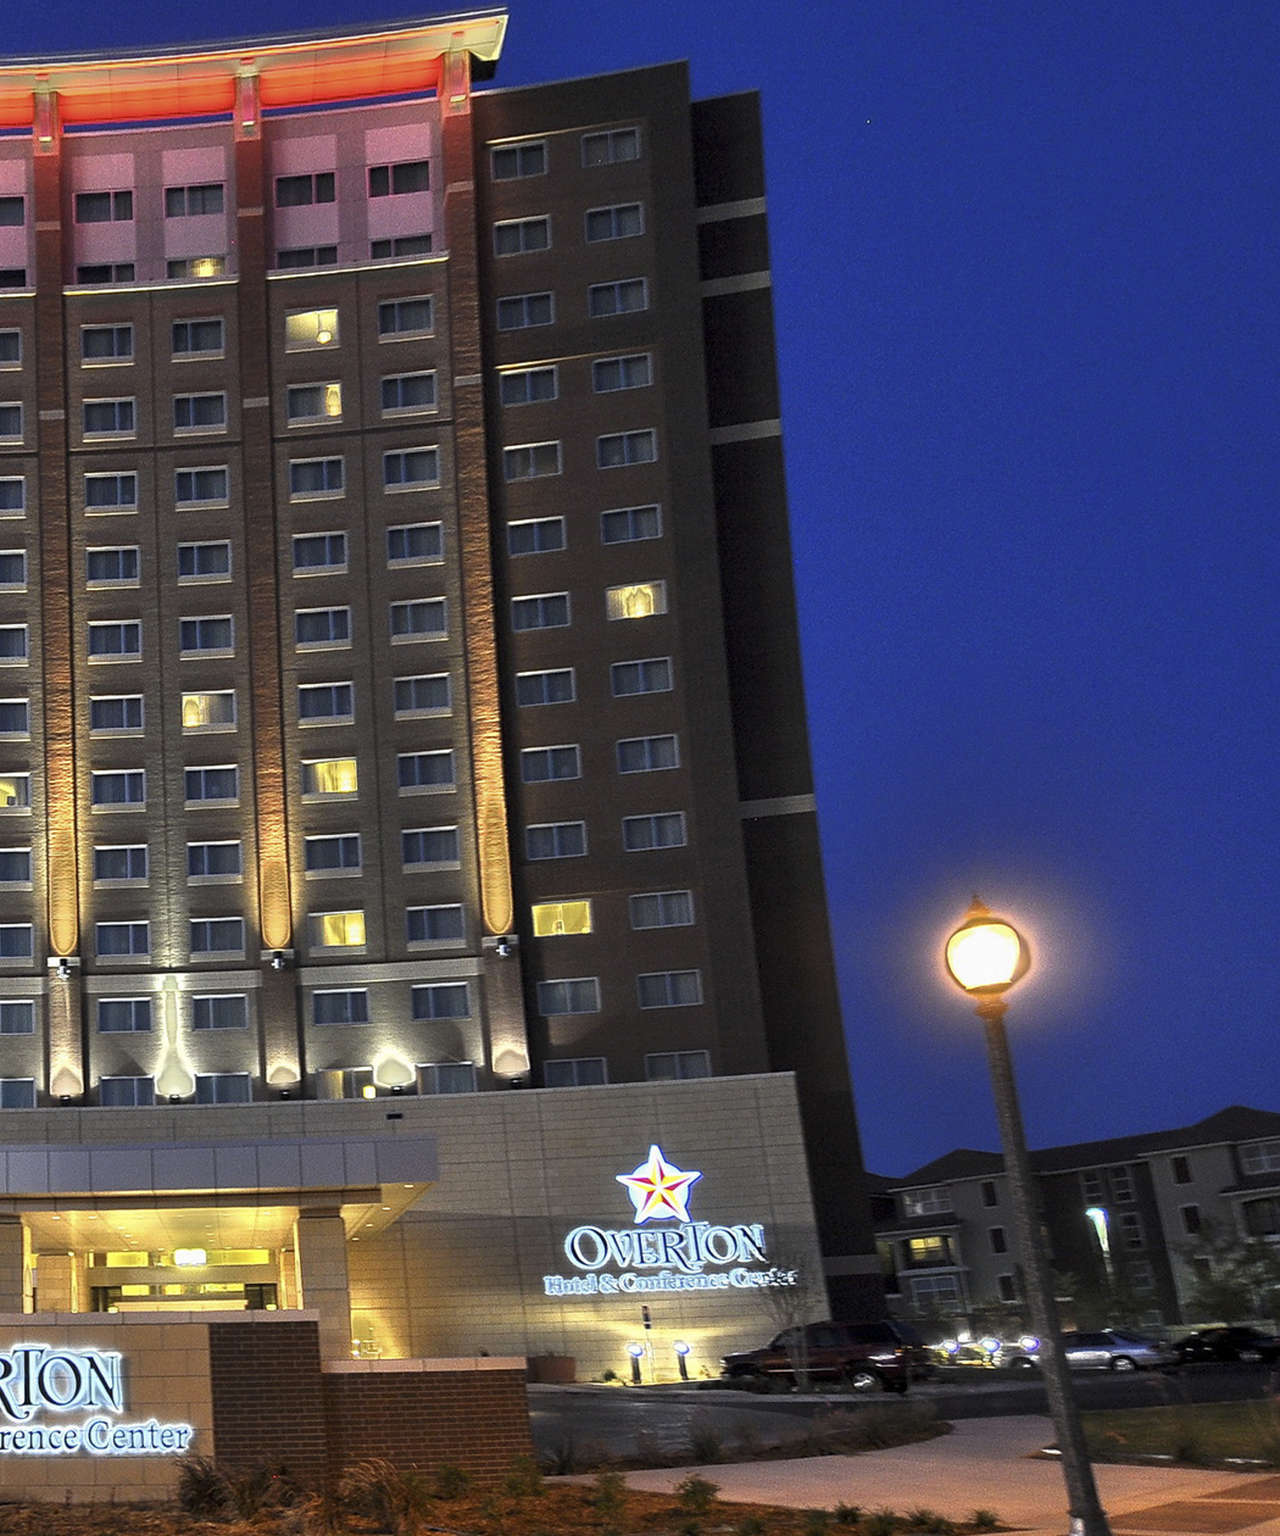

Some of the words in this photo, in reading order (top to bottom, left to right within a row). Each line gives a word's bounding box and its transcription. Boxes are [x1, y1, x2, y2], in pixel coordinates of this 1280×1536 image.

[565, 1222, 768, 1273] OVERTON
[544, 1274, 598, 1294] Hotel
[599, 1274, 619, 1293] &
[620, 1270, 728, 1292] Conference
[87, 1420, 190, 1450] Center
